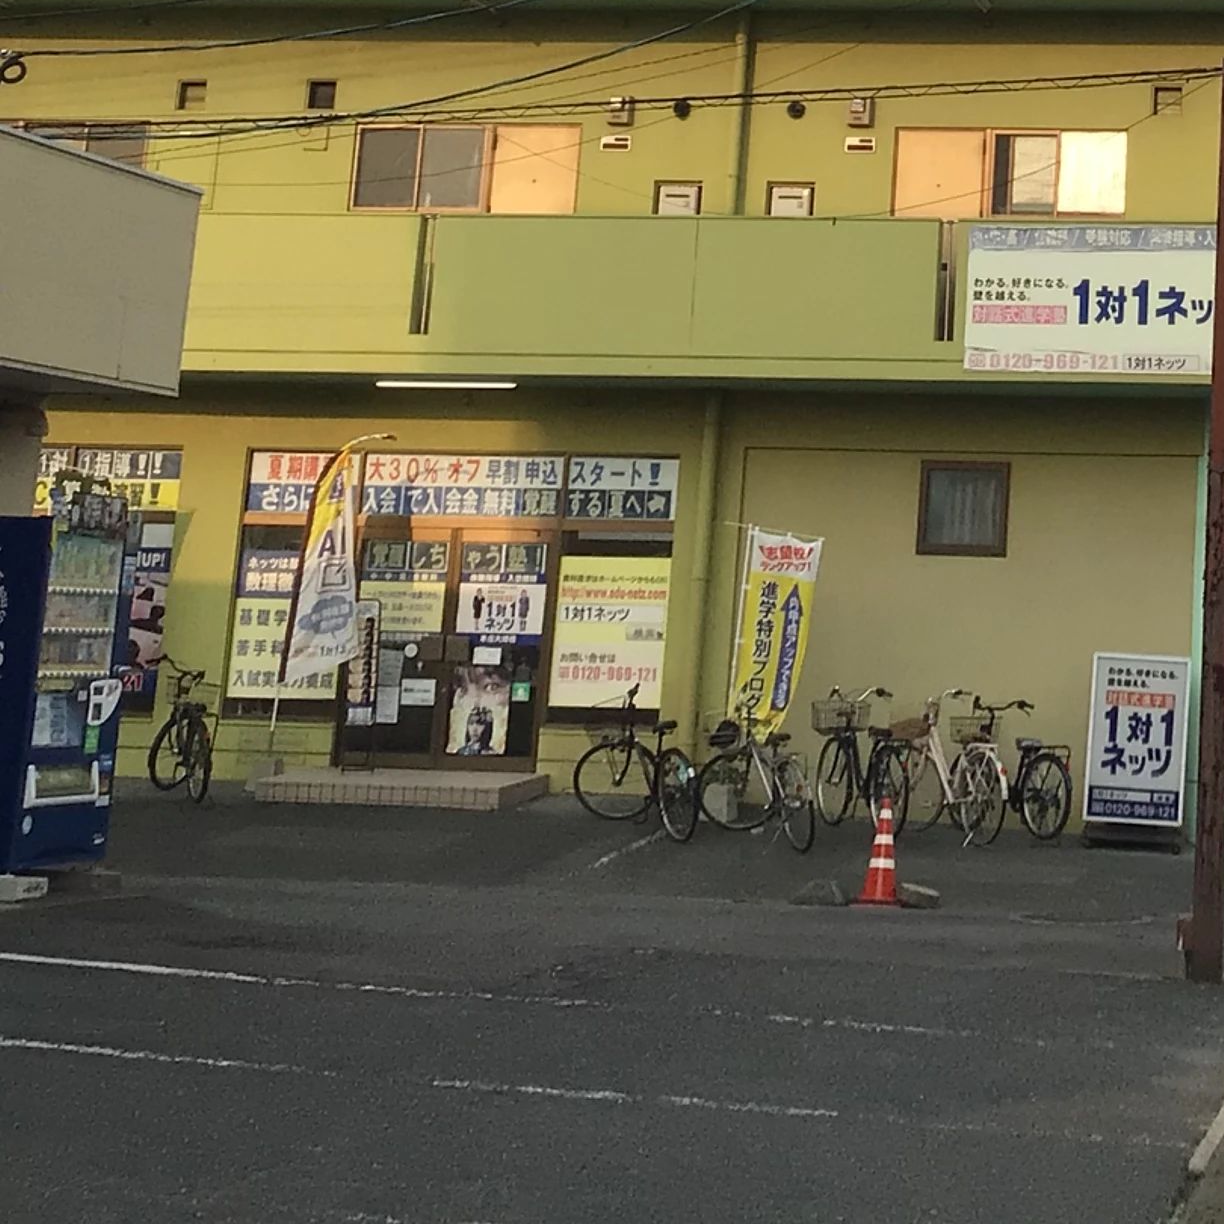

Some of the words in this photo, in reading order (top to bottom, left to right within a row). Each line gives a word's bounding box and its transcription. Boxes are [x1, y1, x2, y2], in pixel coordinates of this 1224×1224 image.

[989, 353, 1119, 370] 0120-969-121
[1127, 356, 1186, 371] 1対1ネッツ
[268, 455, 324, 481] 夏期講
[564, 605, 631, 622] 1対1ネッツ
[571, 665, 657, 682] 0120-969-121
[1105, 705, 1174, 747] 1対1
[1101, 743, 1172, 778] ネッツ
